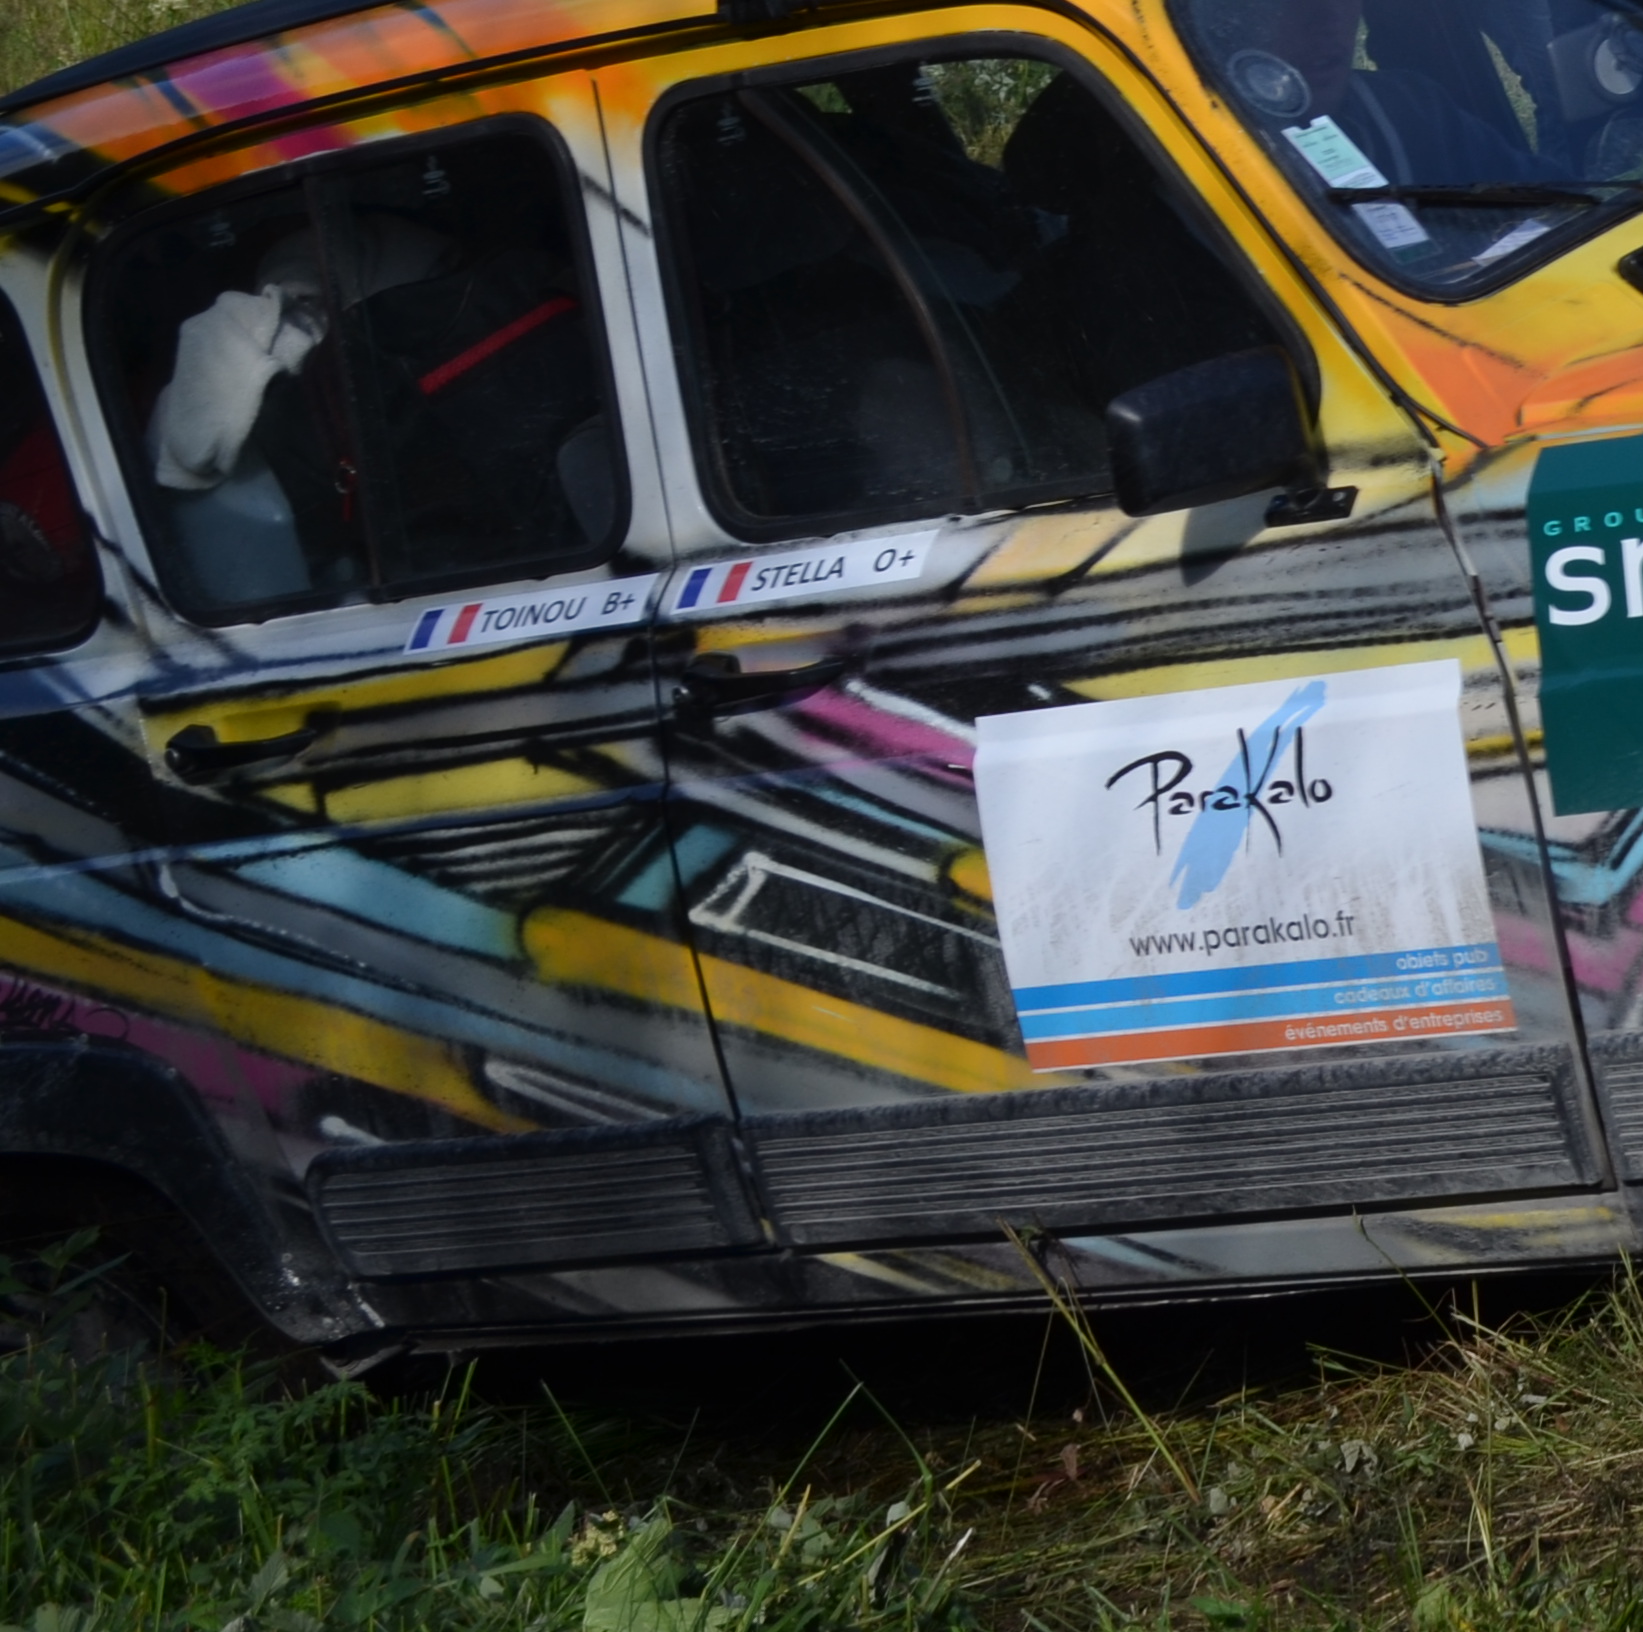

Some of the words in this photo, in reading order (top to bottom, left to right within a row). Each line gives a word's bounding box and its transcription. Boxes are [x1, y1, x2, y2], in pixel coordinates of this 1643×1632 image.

[751, 555, 846, 592] STELLA
[872, 548, 916, 573] O+
[480, 596, 589, 634] TOINOU
[601, 591, 636, 616] B+
[1128, 909, 1355, 957] www.parakalo.fr
[1453, 948, 1489, 968] pub
[1333, 983, 1411, 1005] cadeaux
[1414, 976, 1497, 999] d'affaires
[1284, 1017, 1389, 1041] événements
[1393, 1008, 1505, 1032] d'entreprises
